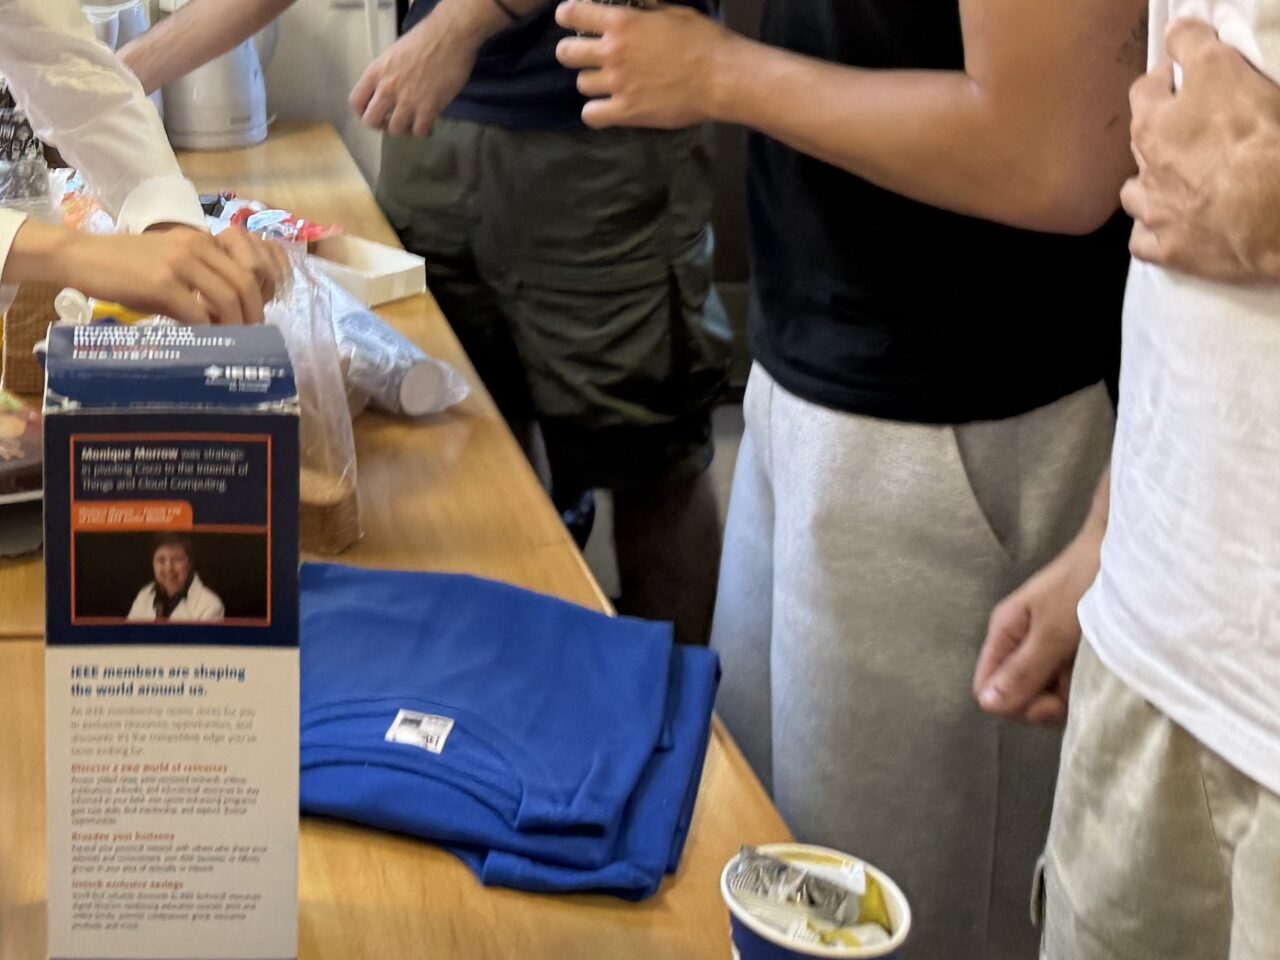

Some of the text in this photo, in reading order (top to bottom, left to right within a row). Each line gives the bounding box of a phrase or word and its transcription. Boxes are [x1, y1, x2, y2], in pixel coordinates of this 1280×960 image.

[225, 365, 271, 379] IEEE
[81, 447, 131, 463] Monique
[134, 447, 179, 461] Morrow
[181, 449, 201, 461] was
[178, 463, 193, 475] the
[197, 463, 235, 475] Internet
[83, 477, 114, 493] Things
[116, 478, 135, 490] and
[138, 478, 167, 490] Cloud
[71, 664, 246, 682] IEEE members are shaping
[71, 682, 92, 697] the
[96, 682, 133, 697] world
[138, 682, 184, 697] around
[143, 763, 169, 773] world
